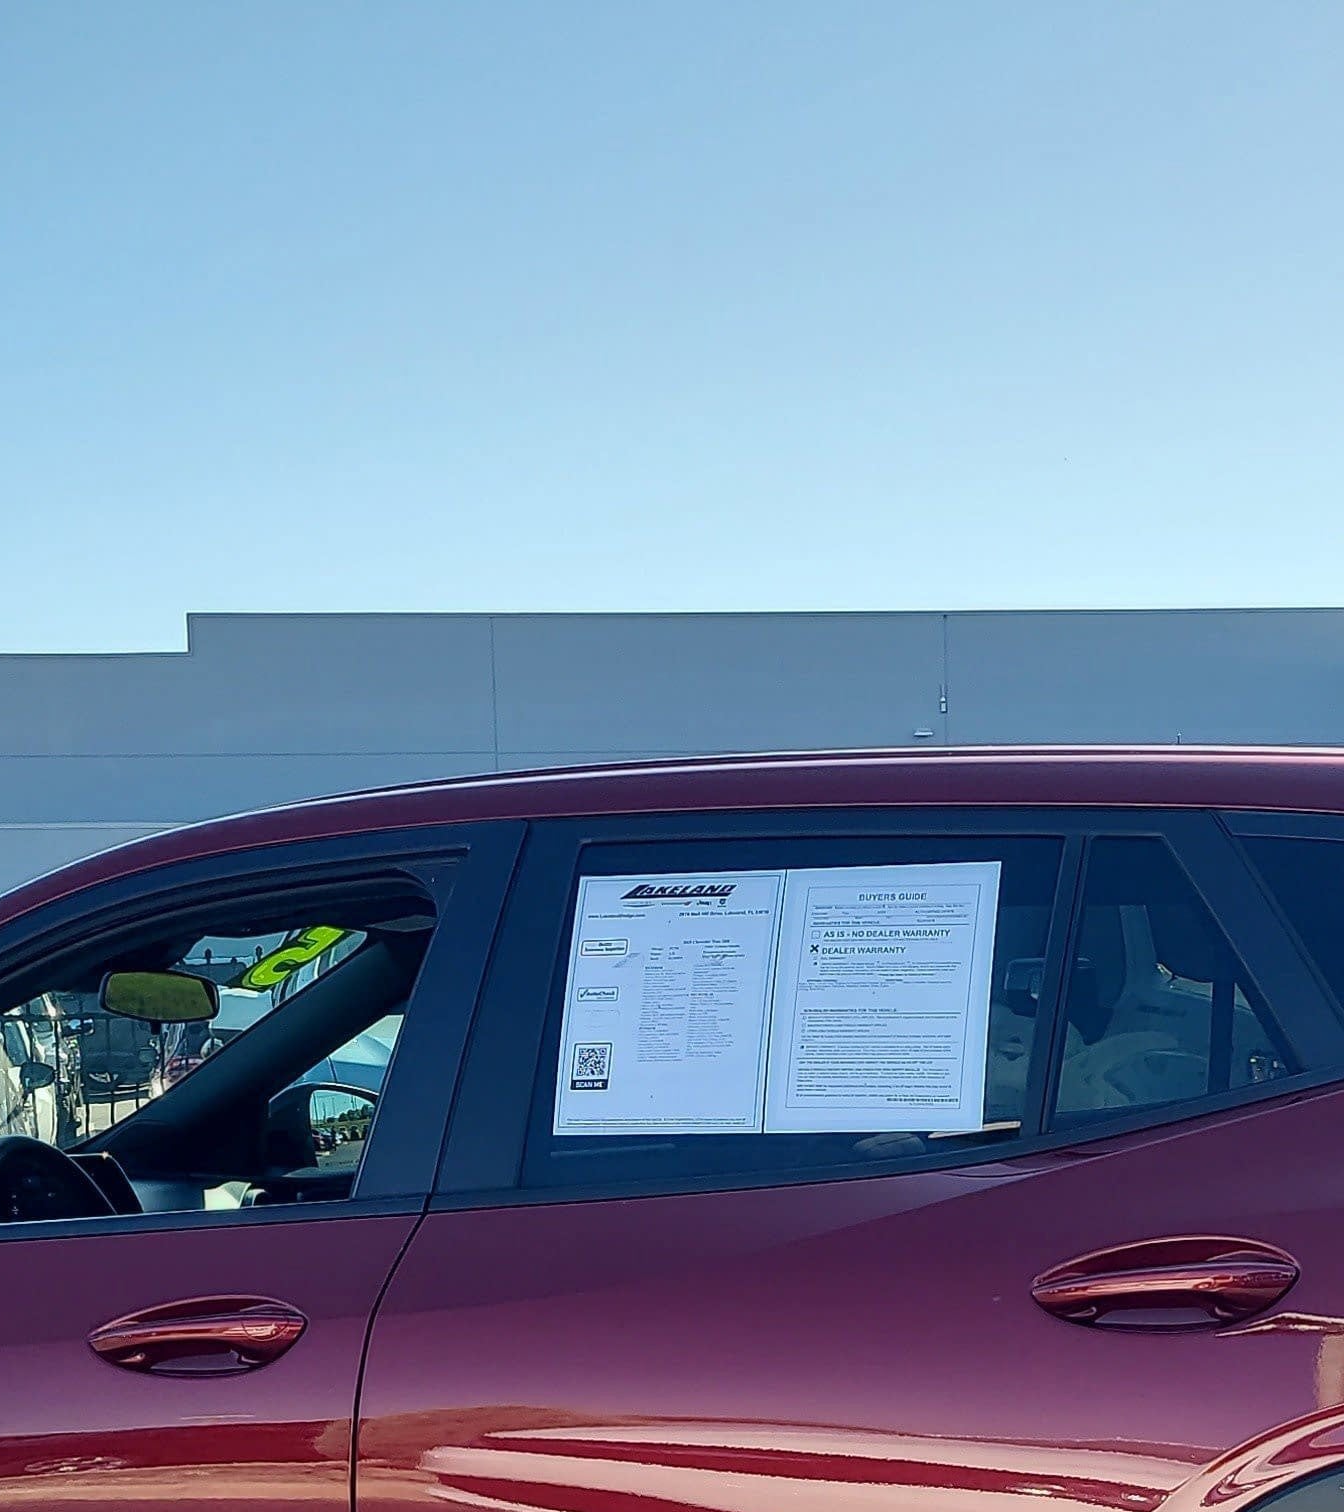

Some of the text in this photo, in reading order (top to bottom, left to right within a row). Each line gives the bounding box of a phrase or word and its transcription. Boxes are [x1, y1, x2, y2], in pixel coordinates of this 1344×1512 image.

[620, 884, 738, 900] LAKELAND
[859, 892, 927, 901] BUYERS GUIDE
[824, 930, 836, 938] AS
[837, 930, 845, 938] IS
[851, 930, 865, 938] NO
[866, 930, 900, 938] DEALER
[901, 929, 951, 937] WARRANTY
[822, 946, 906, 955] DEALER WARRANTY
